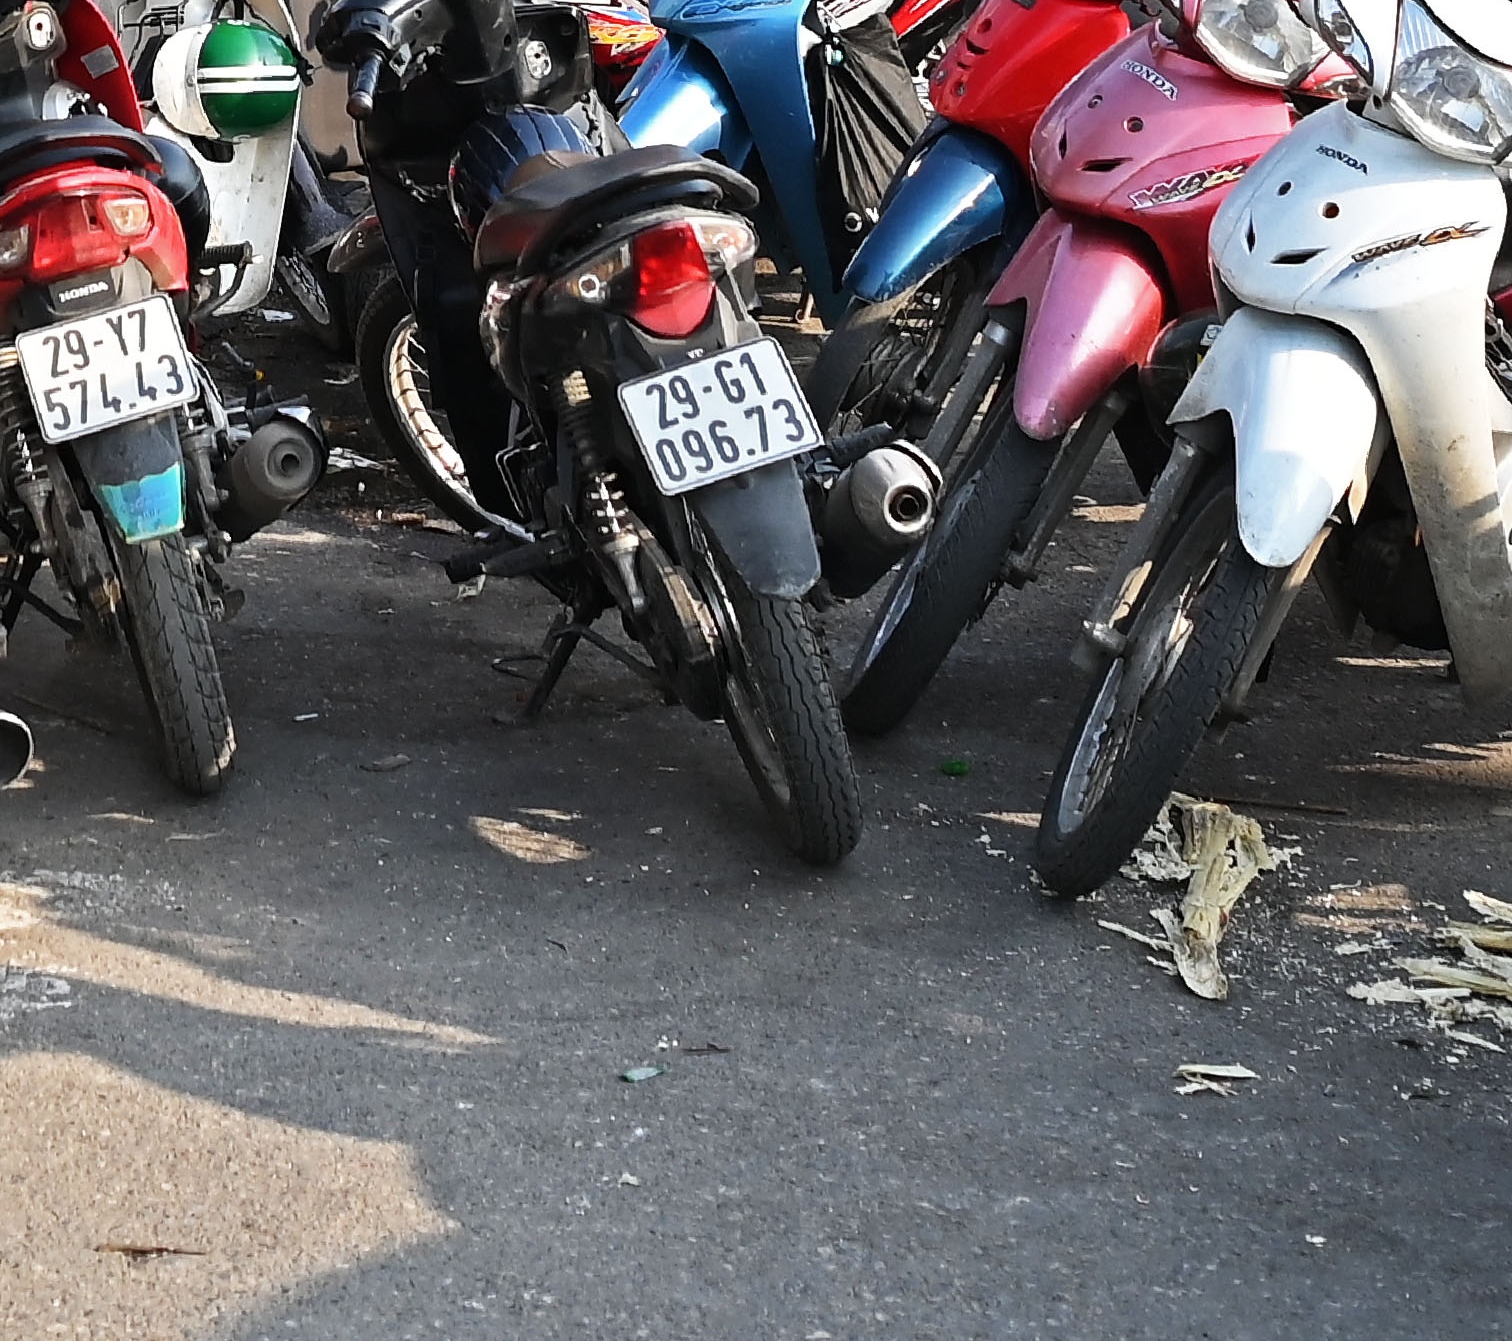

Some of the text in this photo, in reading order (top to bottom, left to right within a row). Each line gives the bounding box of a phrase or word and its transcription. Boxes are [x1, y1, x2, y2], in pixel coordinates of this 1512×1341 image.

[1120, 59, 1178, 102] HONDA
[1315, 143, 1369, 176] HONDA
[58, 280, 109, 303] HONDA
[42, 308, 147, 378] 29-Y7
[43, 354, 184, 431] 574.43
[645, 352, 769, 430] 29-G1
[655, 398, 805, 482] 096.73
